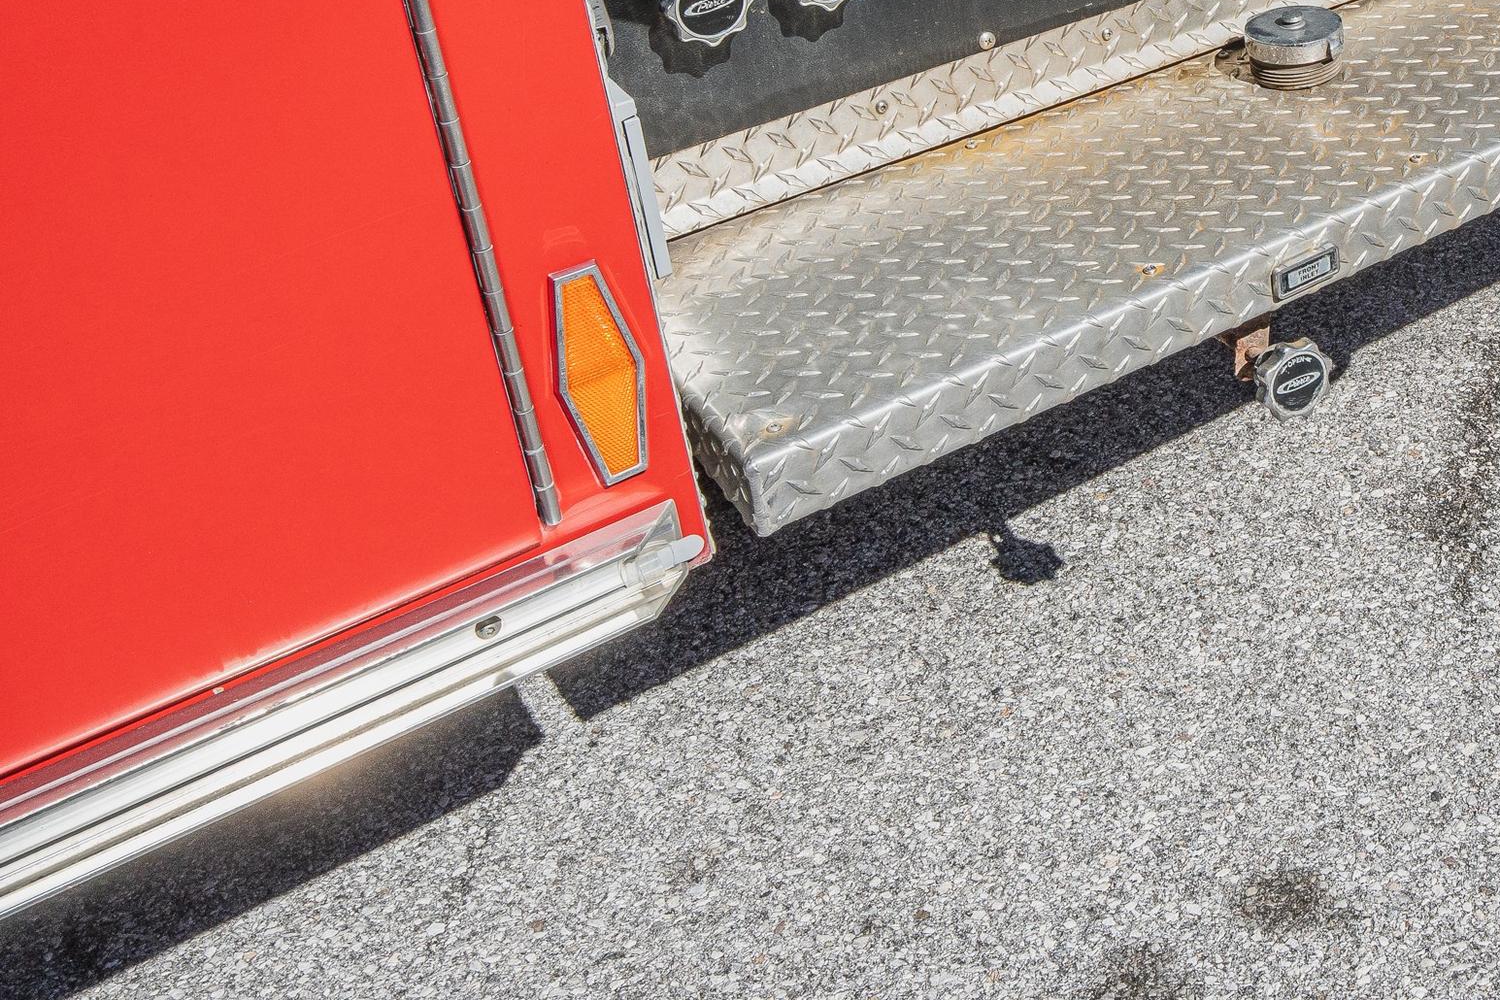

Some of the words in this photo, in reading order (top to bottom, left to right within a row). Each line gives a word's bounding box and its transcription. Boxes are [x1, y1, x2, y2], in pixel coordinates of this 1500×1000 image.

[1298, 262, 1320, 275] FRONT
[1300, 269, 1319, 281] INLET
[1287, 355, 1306, 368] OPEN
[1286, 375, 1312, 391] Pierce
